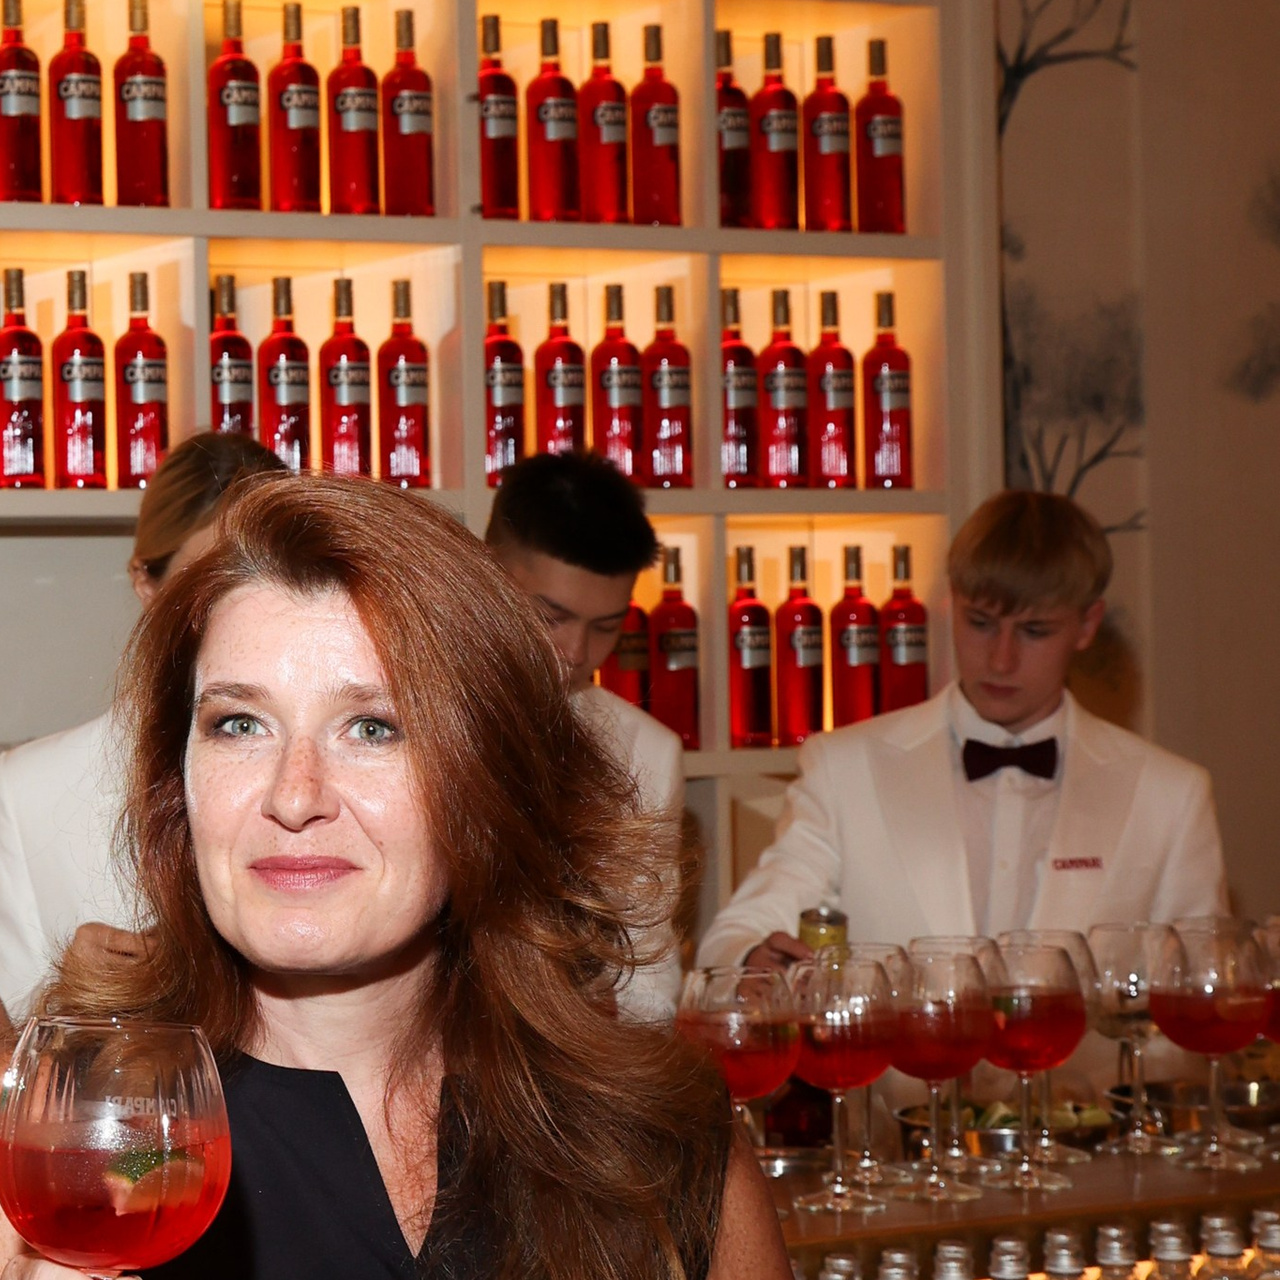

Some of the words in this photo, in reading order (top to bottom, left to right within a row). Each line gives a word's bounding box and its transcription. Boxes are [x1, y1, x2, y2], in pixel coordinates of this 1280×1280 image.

[60, 81, 100, 99] CAMPA
[123, 82, 165, 100] CAMPA
[222, 87, 258, 105] CAMP
[283, 92, 318, 108] CAMP
[337, 95, 377, 112] CAMPA
[394, 99, 432, 114] CAMPA
[0, 363, 41, 380] CAMPA
[64, 363, 103, 380] CAMPA
[127, 364, 166, 381] CAMPA
[214, 366, 251, 383] CAMPA
[271, 367, 308, 385] CAMPA
[331, 368, 369, 385] CAMPA
[391, 369, 428, 386] CAMP
